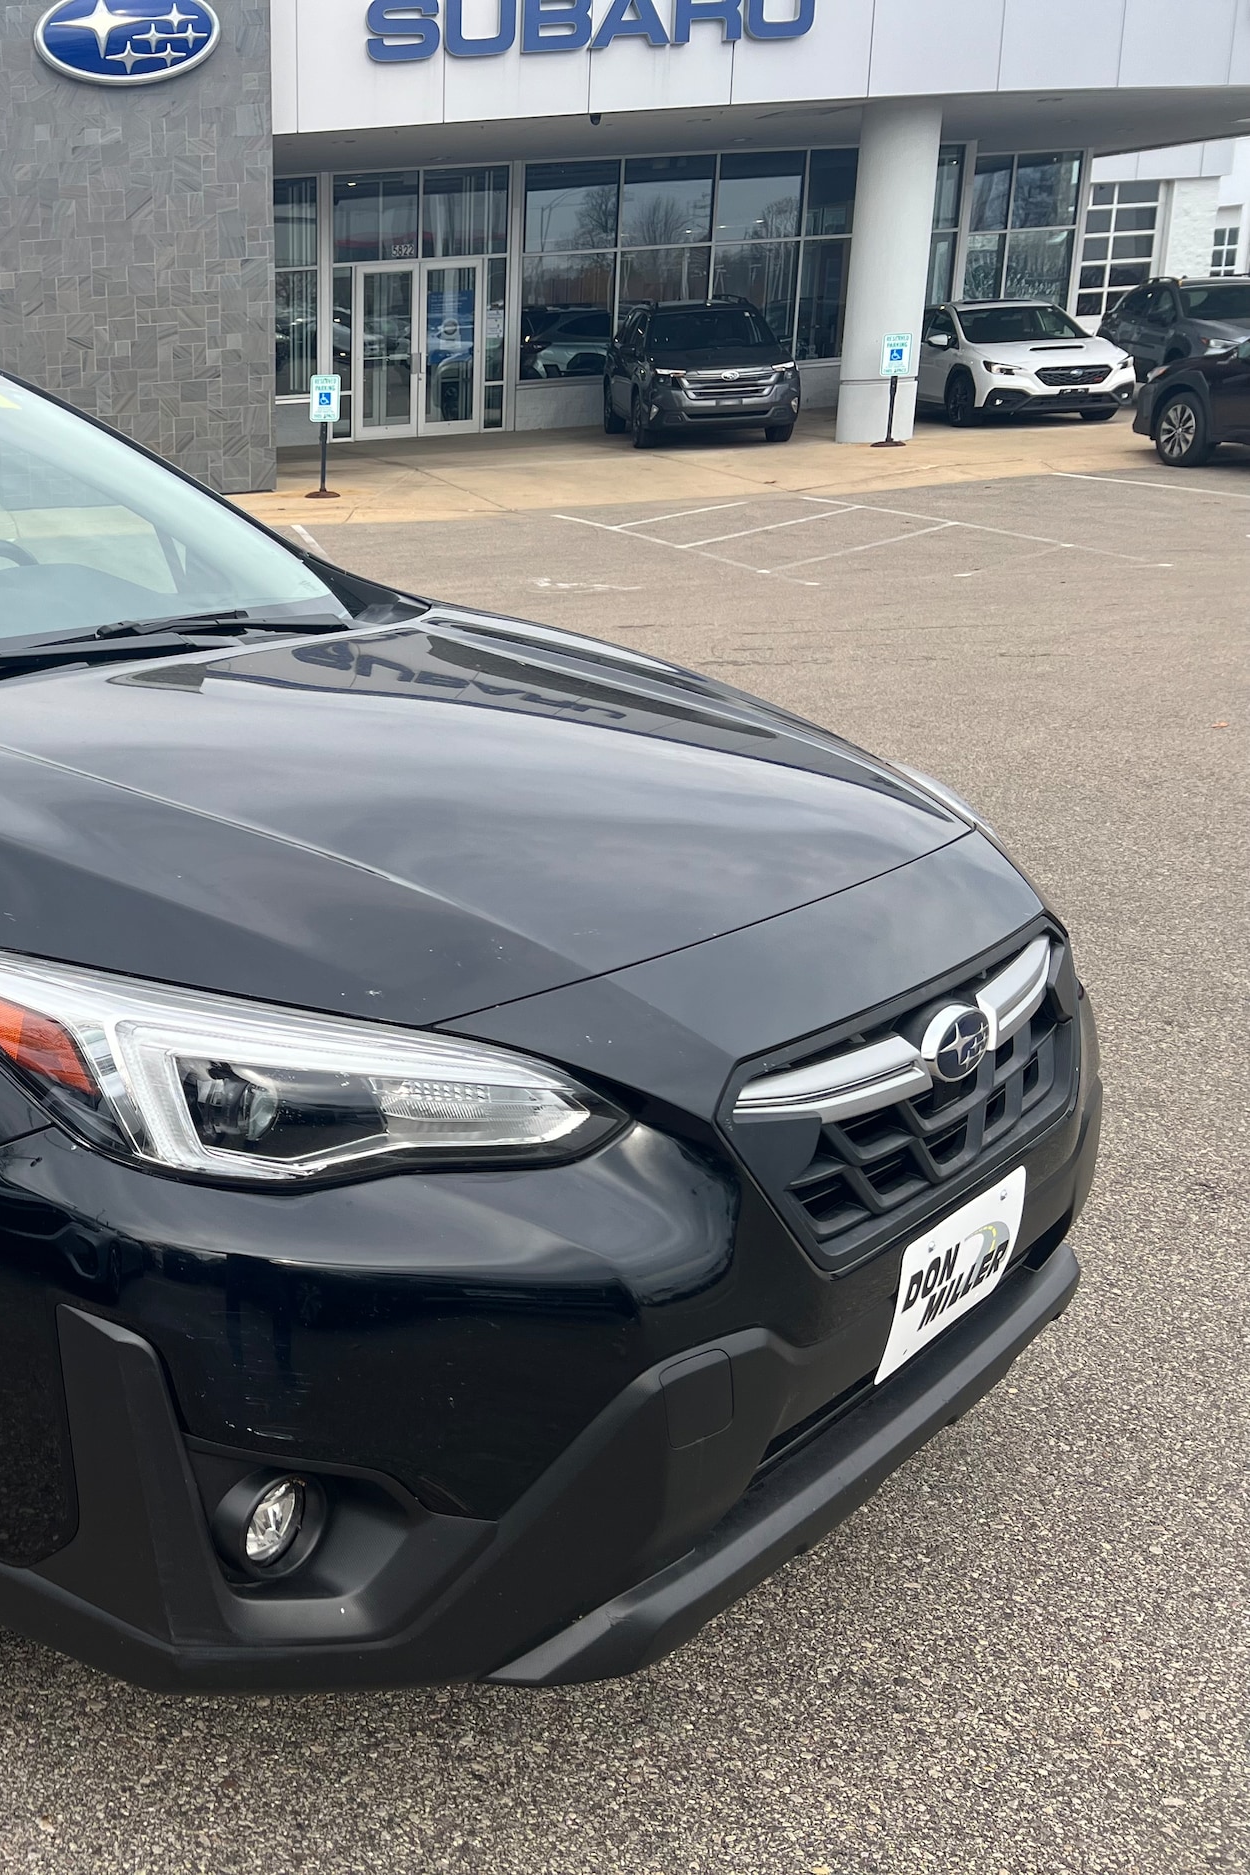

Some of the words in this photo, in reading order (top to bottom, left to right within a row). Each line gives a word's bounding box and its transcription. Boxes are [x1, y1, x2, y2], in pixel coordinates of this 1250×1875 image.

[366, 0, 817, 63] SUBARU
[391, 244, 415, 257] 5822
[901, 1242, 961, 1314] DON
[916, 1239, 1009, 1332] MILLER
